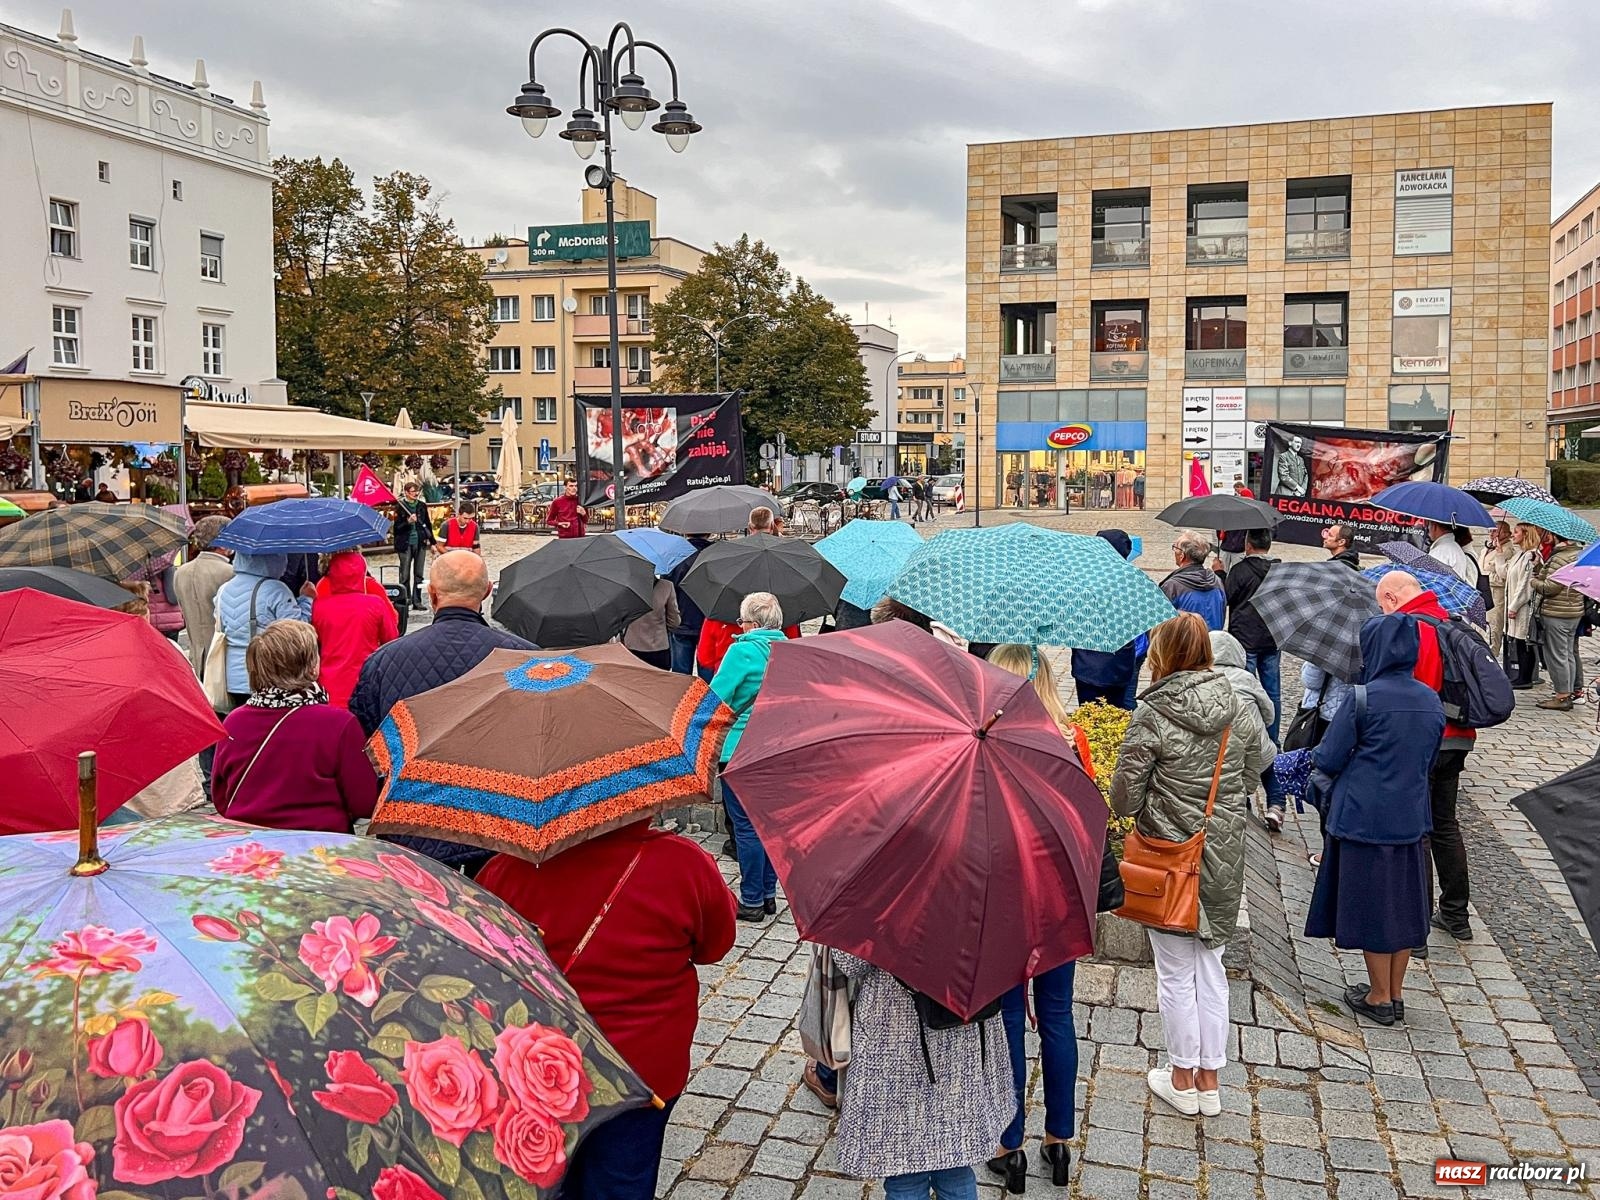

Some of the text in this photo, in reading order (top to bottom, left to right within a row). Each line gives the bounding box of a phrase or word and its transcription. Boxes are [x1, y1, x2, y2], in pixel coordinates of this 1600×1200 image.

[1400, 172, 1447, 182] KANCELARIA
[1399, 182, 1448, 191] ADWOKACKA
[558, 235, 620, 247] McDonals
[1192, 357, 1239, 368] KOFEINKA
[860, 433, 880, 442] STUDIO
[1053, 432, 1086, 440] PEPCO
[688, 441, 730, 457] zabijaj.
[1379, 524, 1400, 533] Adolfa
